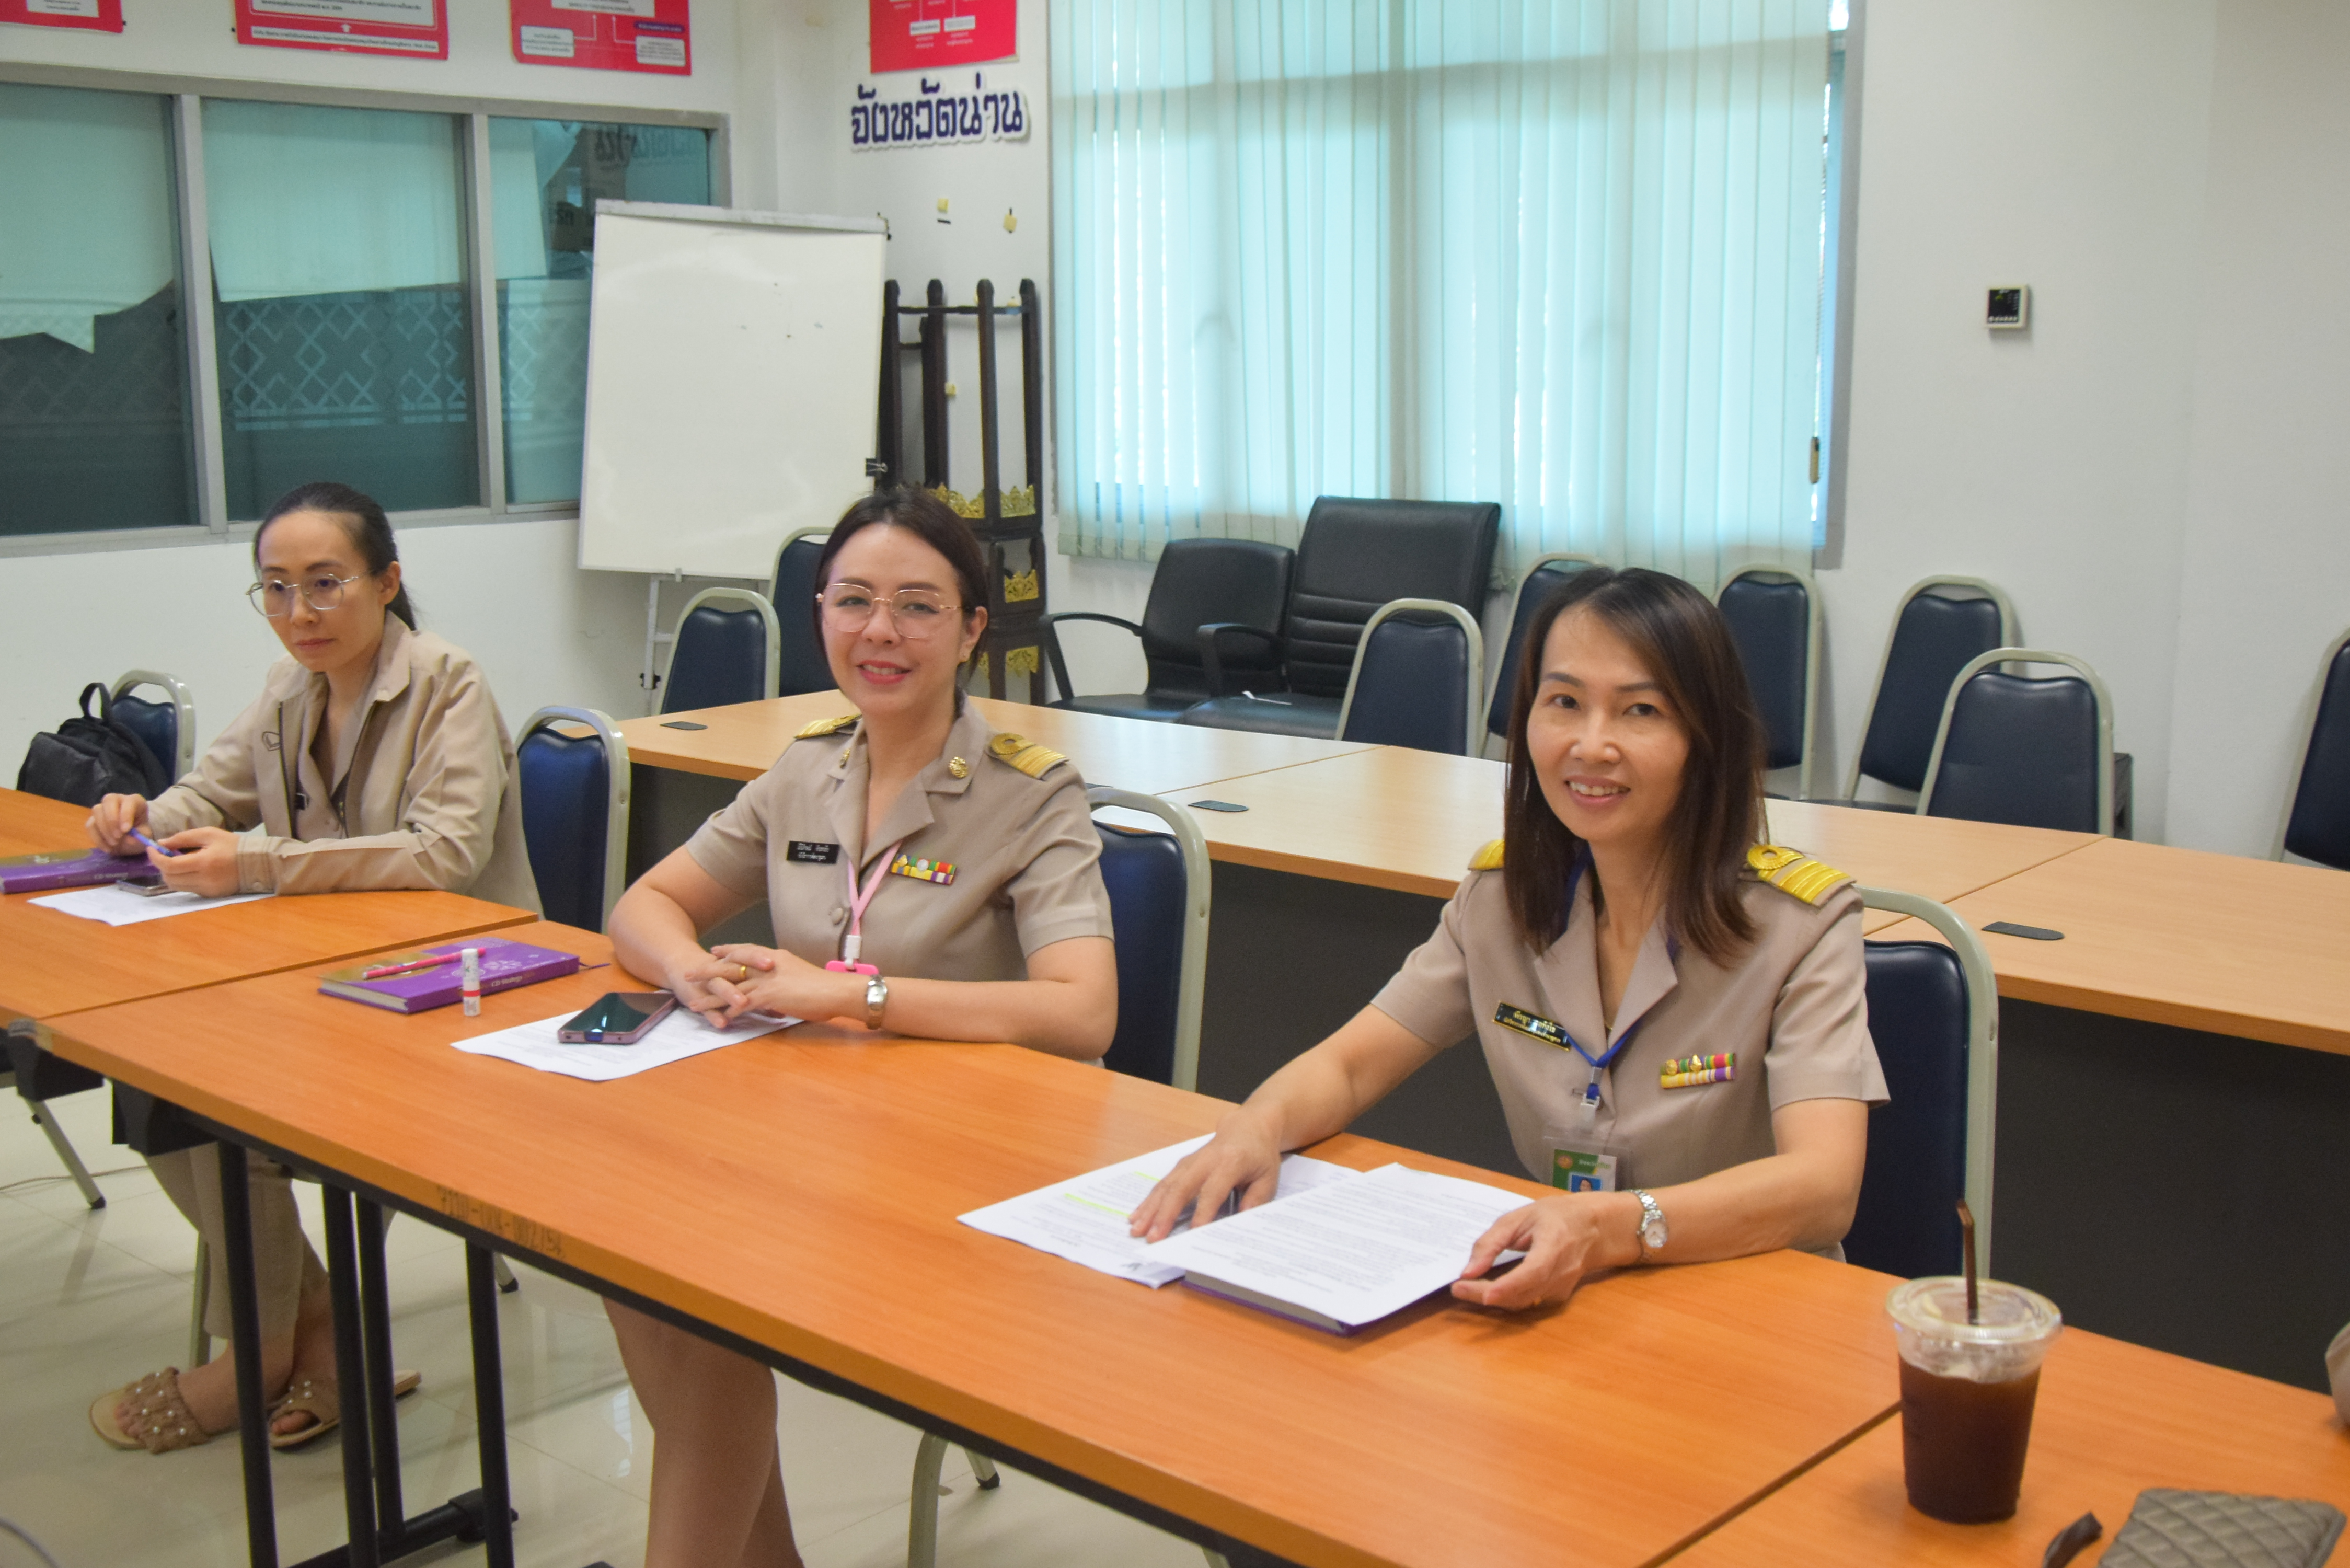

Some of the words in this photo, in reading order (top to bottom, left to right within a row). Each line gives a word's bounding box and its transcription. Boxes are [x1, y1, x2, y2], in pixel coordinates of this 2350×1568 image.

[851, 73, 1023, 144] จังหวัดน่าน
